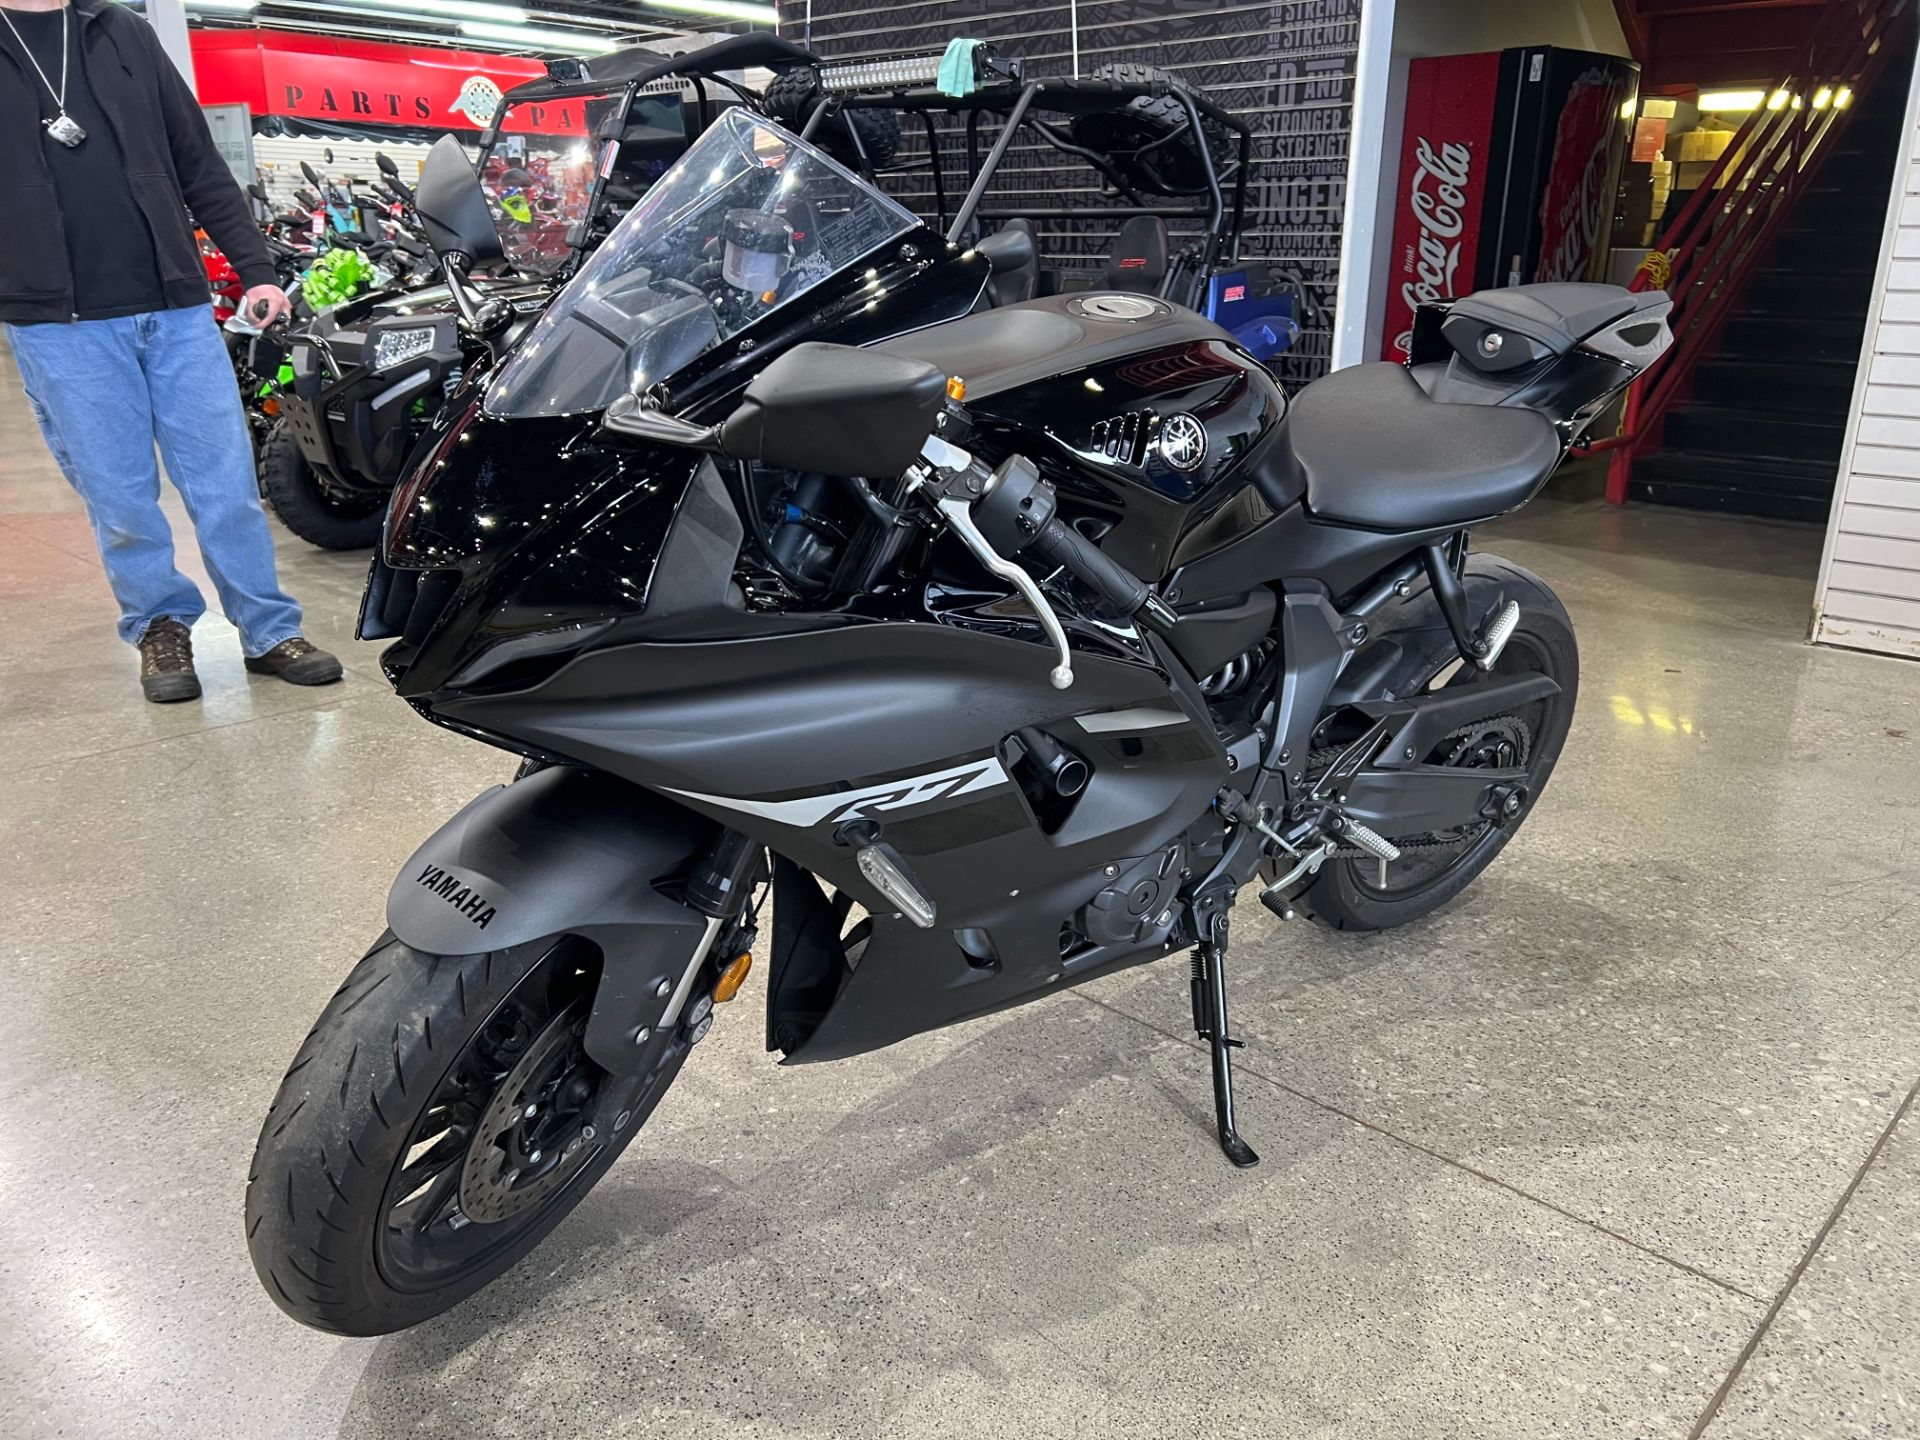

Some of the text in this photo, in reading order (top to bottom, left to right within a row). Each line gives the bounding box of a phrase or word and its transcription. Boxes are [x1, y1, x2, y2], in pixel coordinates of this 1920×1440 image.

[284, 85, 430, 119] PARTS
[530, 106, 586, 128] PA
[822, 760, 1000, 824] R7
[416, 864, 497, 930] YAMAHA
